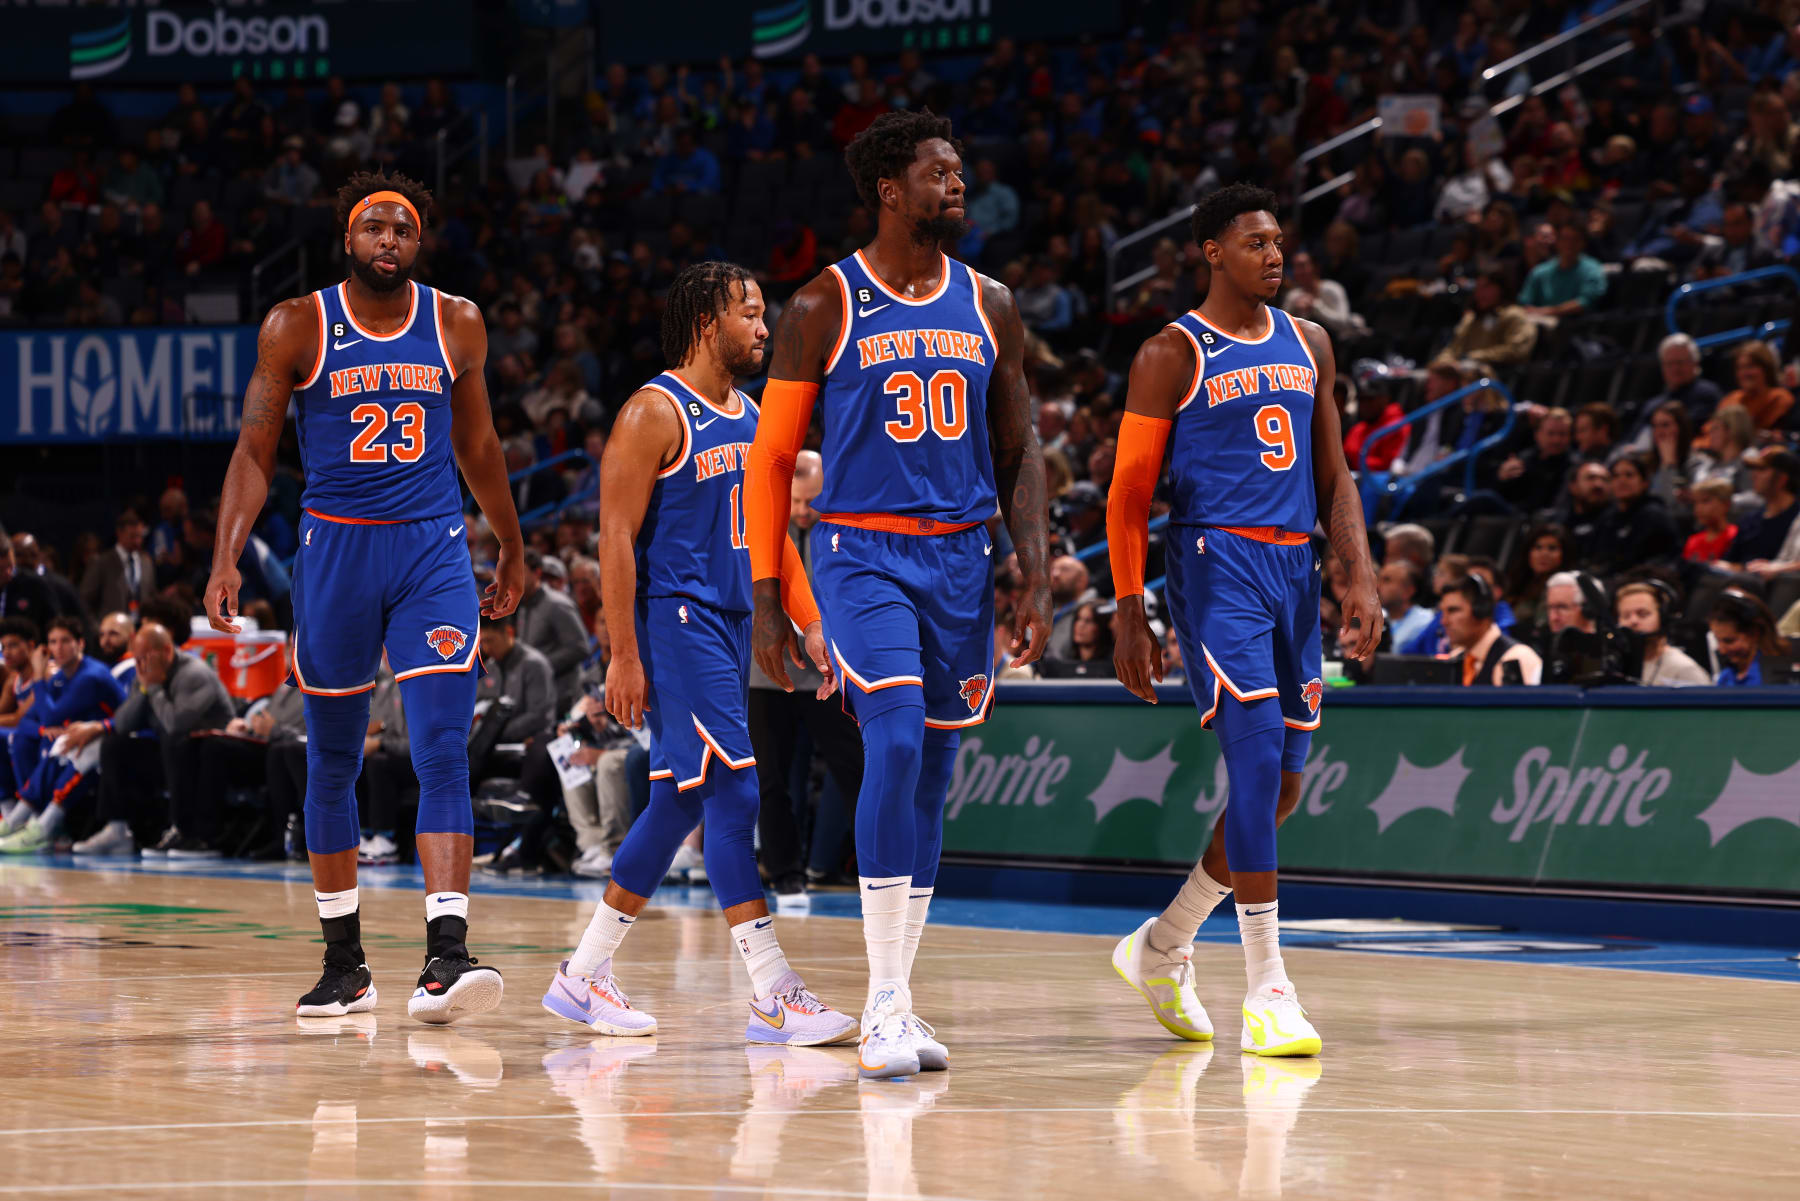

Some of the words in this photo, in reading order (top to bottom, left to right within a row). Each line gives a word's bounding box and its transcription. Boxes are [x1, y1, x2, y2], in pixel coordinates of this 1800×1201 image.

[146, 9, 328, 56] Dobson
[825, 0, 989, 30] Dobson
[232, 60, 330, 79] FIBER
[858, 289, 871, 302] 6
[334, 323, 344, 336] 6
[857, 331, 916, 369] NEW
[917, 329, 986, 366] YORK
[1202, 332, 1214, 344] 6
[329, 364, 383, 398] NEW
[384, 363, 443, 394] YORK
[1204, 365, 1260, 408] NEW
[1258, 364, 1314, 398] YORK
[689, 402, 701, 416] 6
[883, 369, 968, 443] 30
[350, 402, 426, 463] 23
[1253, 403, 1297, 472] 9
[694, 443, 738, 483] NEW
[729, 484, 750, 549] 1
[946, 735, 1071, 820] Sprite
[1490, 744, 1671, 842] Sprite
